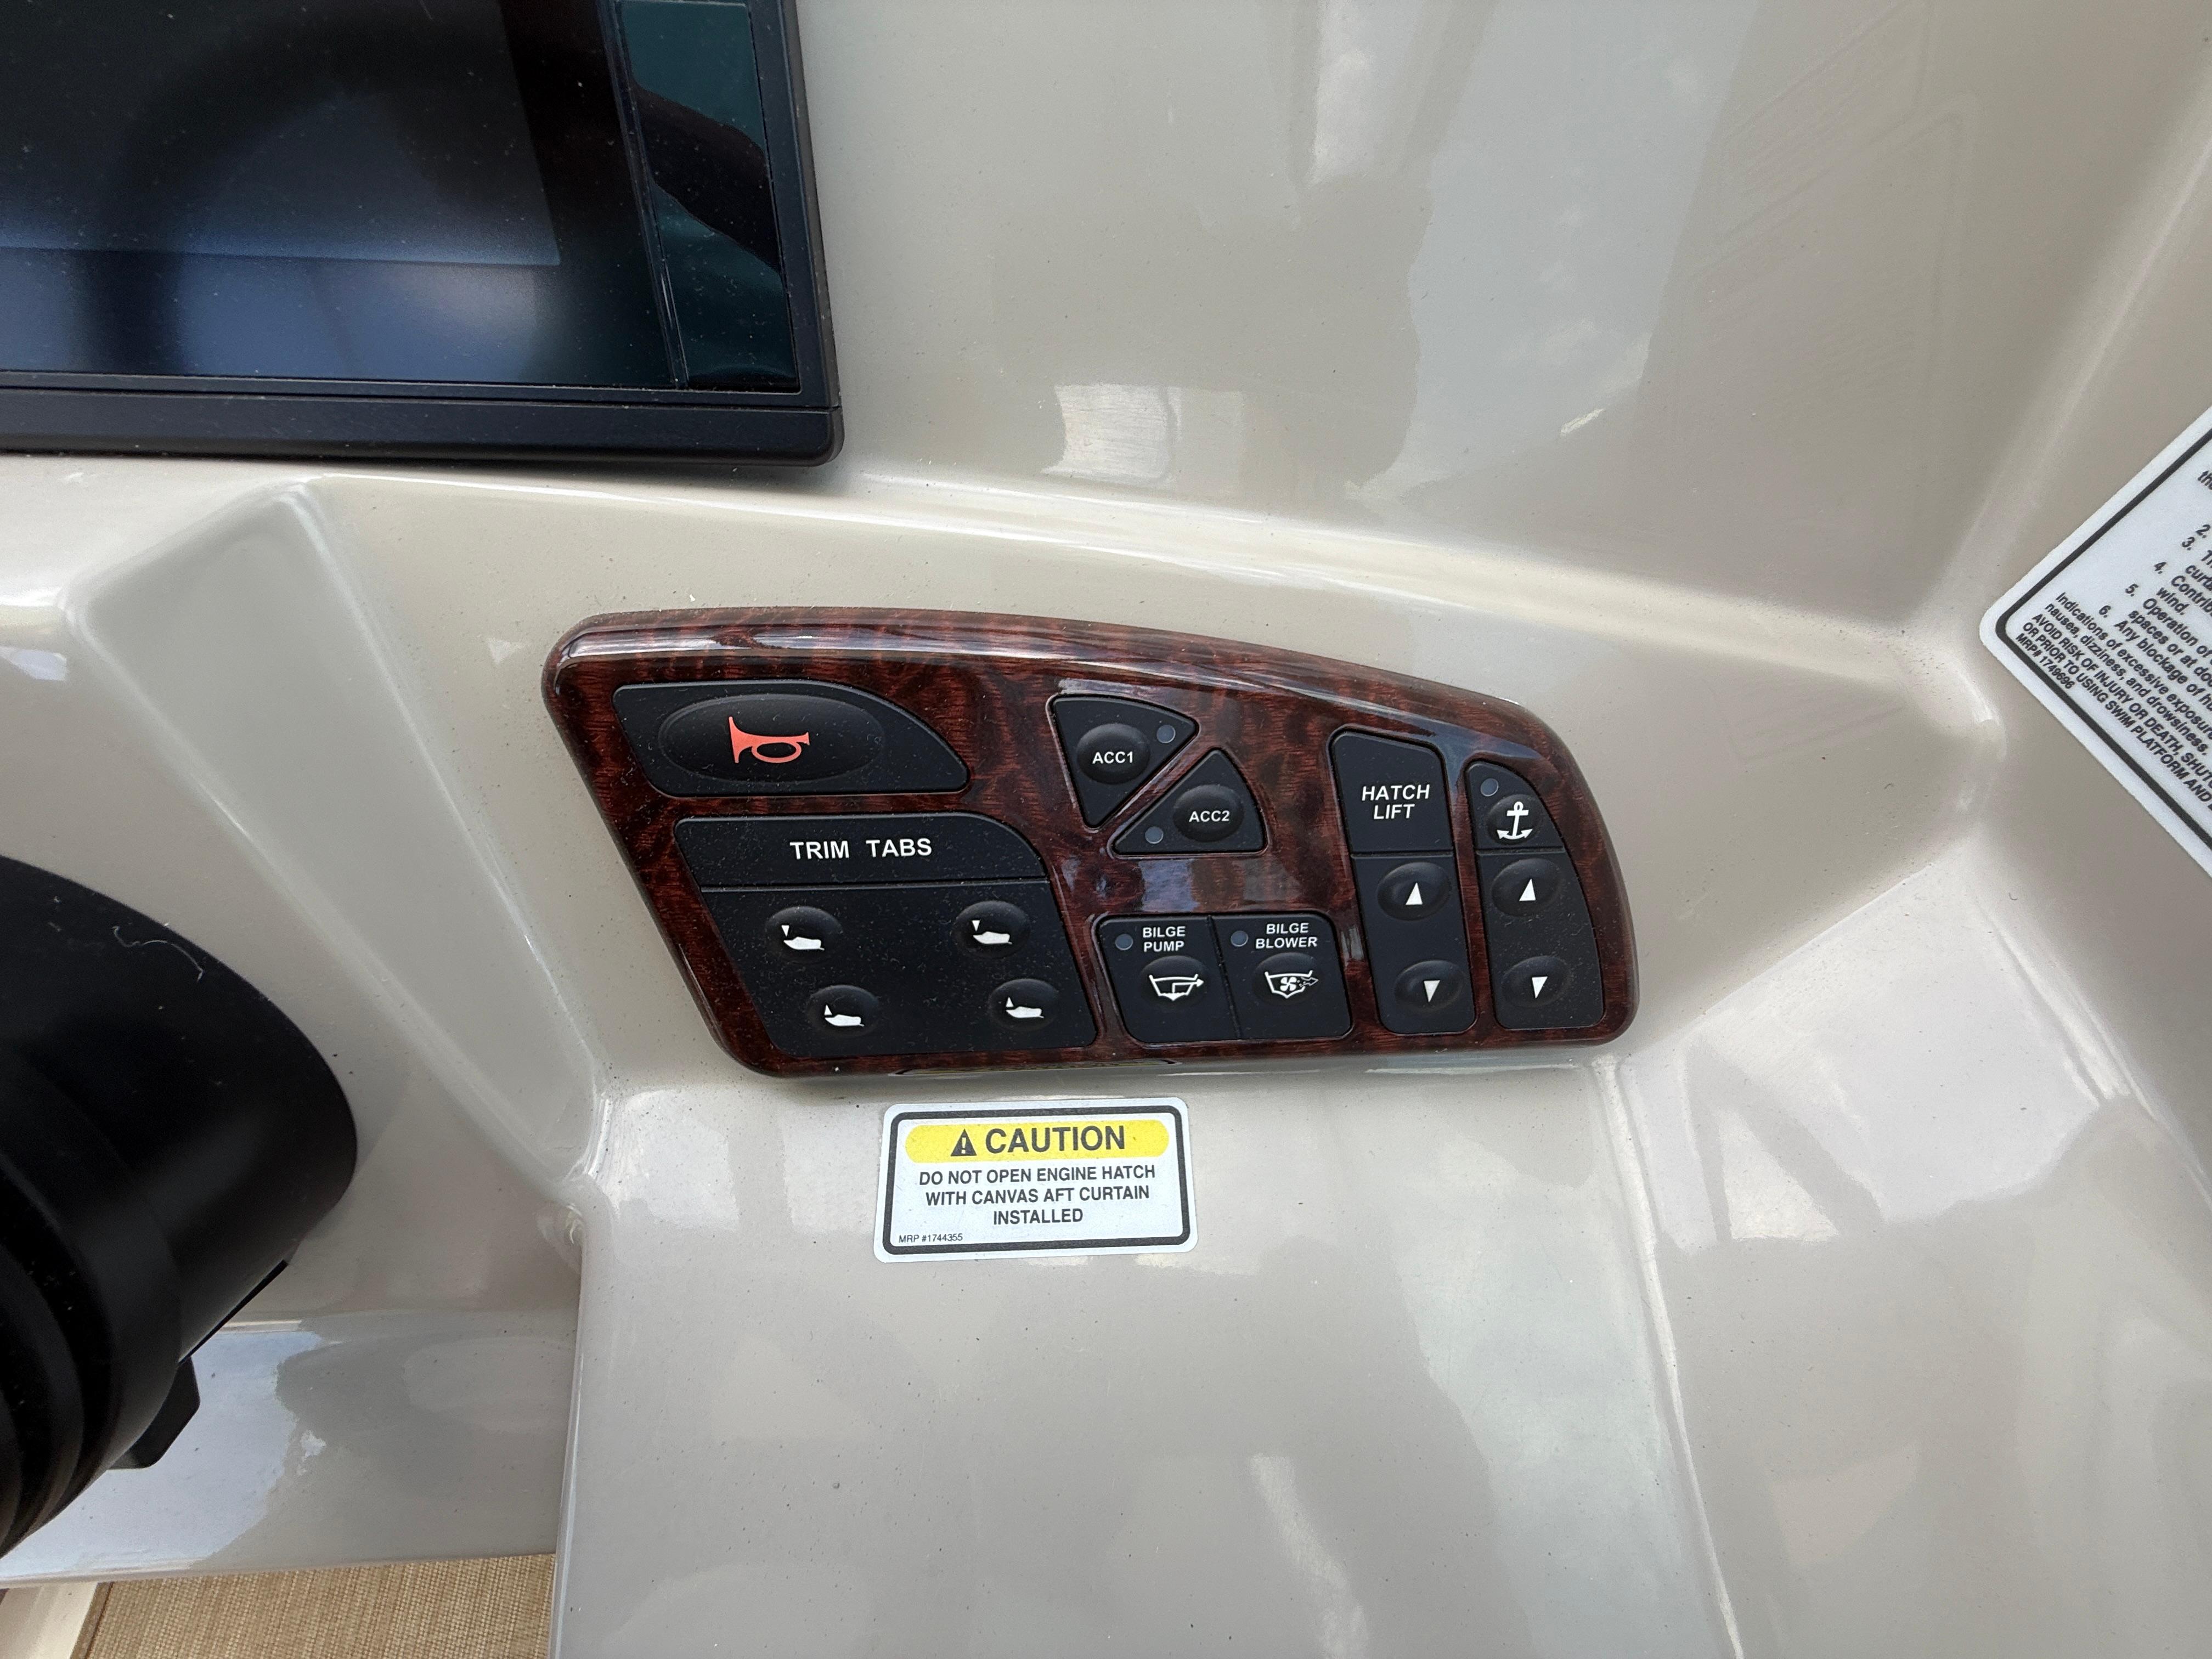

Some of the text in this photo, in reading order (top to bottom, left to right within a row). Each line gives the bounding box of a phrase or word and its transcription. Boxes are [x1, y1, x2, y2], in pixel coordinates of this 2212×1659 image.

[2196, 524, 2210, 538] 2.
[2181, 537, 2196, 550] 3.
[2154, 562, 2212, 617] 4. Contrib
[2156, 587, 2190, 615] wind.
[2125, 583, 2138, 596] 5.
[2143, 597, 2198, 646] Operation
[2016, 633, 2042, 657] MRP#
[2056, 592, 2108, 640] Indications
[2106, 639, 2123, 650] of
[2118, 649, 2169, 695] excessive
[2128, 610, 2169, 645] spaces
[2168, 644, 2184, 656] or
[2180, 655, 2198, 668] at
[2098, 605, 2111, 618] 6.
[2114, 620, 2140, 642] Any
[2136, 637, 2188, 684] blockage
[2186, 684, 2205, 696] of
[2032, 614, 2062, 640] AVOID
[2058, 637, 2085, 661] RISK
[2081, 658, 2099, 671] OF
[2094, 670, 2134, 704] INJURY
[2129, 703, 2148, 720] OR
[2144, 717, 2183, 756] DEATH,
[2045, 603, 2208, 755] nausea, dizziness, and drowsiness.
[2023, 622, 2212, 802] OR PRIOR TO USING SWIM PLATFORM AND
[1092, 751, 1133, 764] ACC1
[1361, 784, 1430, 802] HATCH
[1188, 810, 1230, 823] ACC2
[1373, 804, 1415, 820] LIFT
[789, 838, 933, 860] TRIM TABS
[1142, 926, 1186, 938] BILGE
[1266, 922, 1310, 935] BILGE
[1143, 940, 1185, 952] PUMP
[1255, 936, 1318, 949] BLOWER
[985, 1125, 1126, 1153] CAUTION
[919, 1164, 1156, 1186] DO NOT OPEN ENGINE HATCH
[926, 1185, 1150, 1206] WITH CANVAS AFT CURTAIN
[992, 1208, 1084, 1225] INSTALLED
[899, 1233, 963, 1243] MRP #1744355
